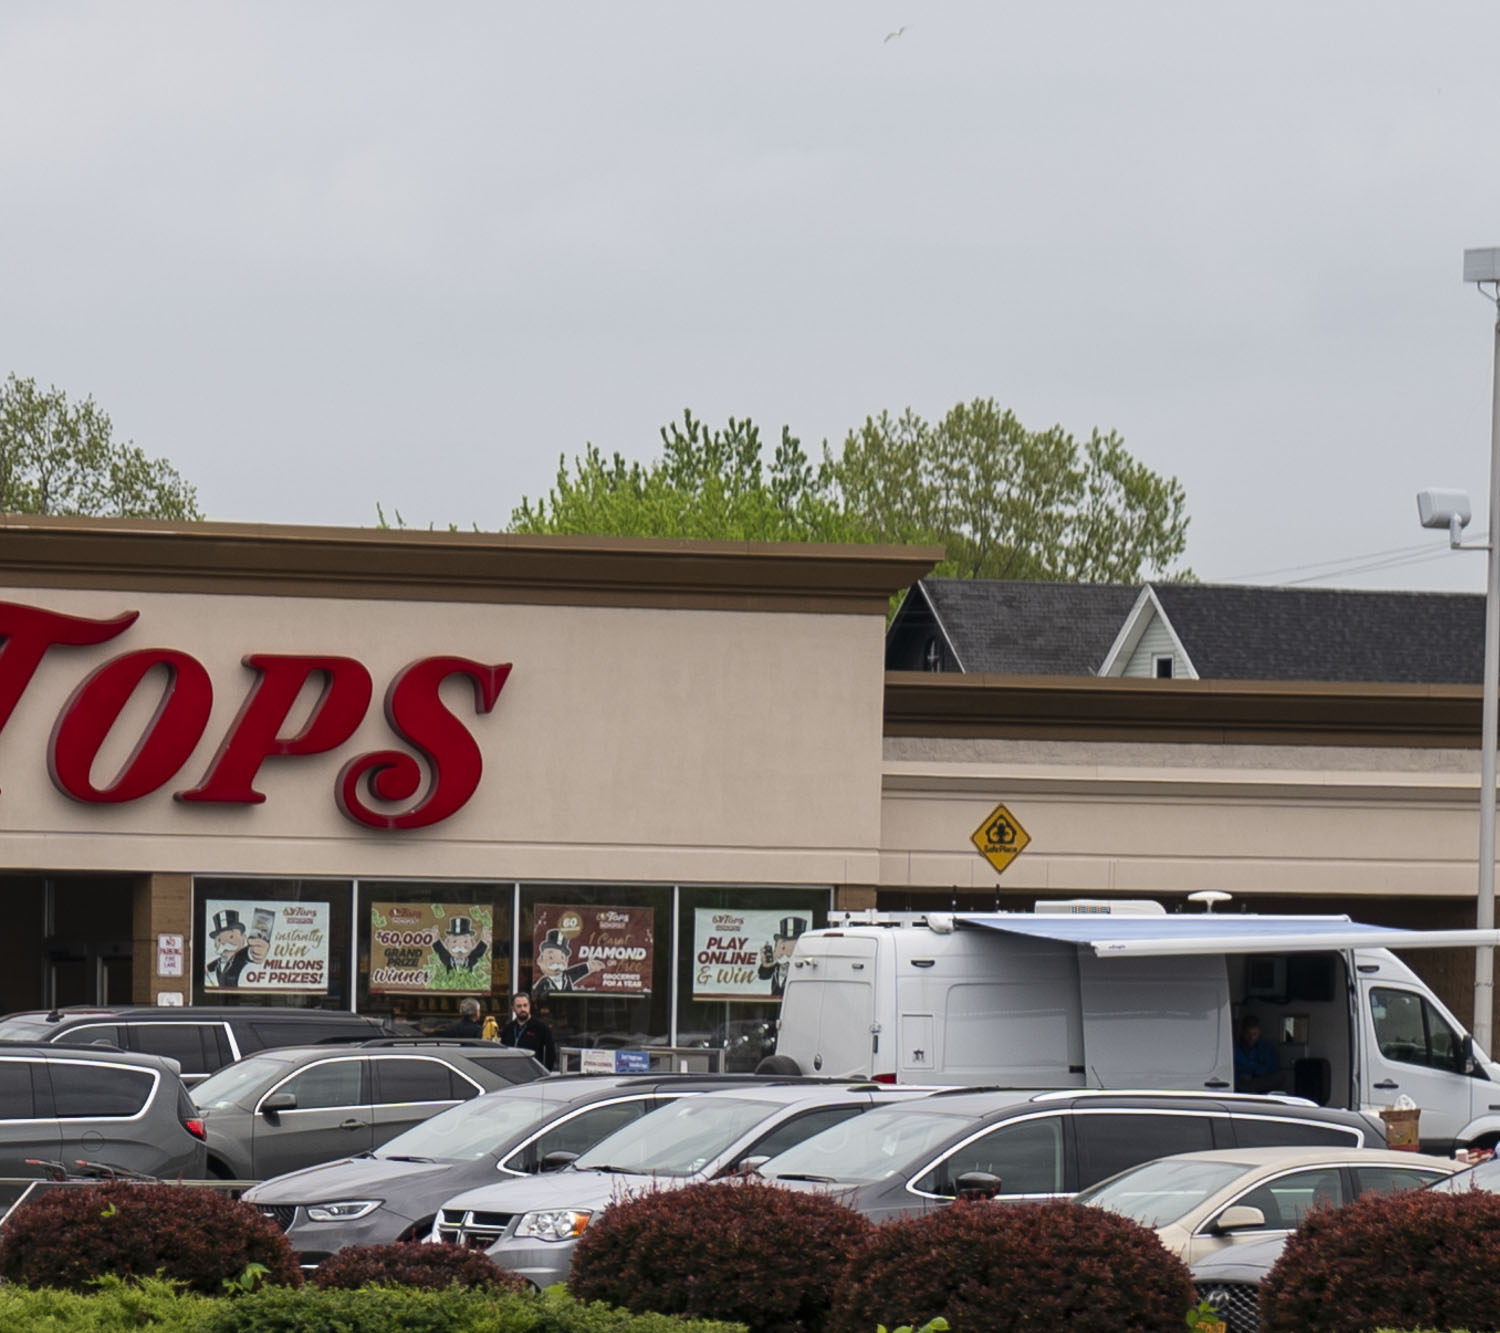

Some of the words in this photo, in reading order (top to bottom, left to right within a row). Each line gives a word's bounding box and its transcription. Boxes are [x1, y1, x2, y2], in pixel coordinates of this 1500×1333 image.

[376, 931, 433, 946] $60,000
[707, 937, 749, 950] PLAY
[384, 948, 423, 957] GRAND
[578, 946, 646, 960] DIAMOND
[698, 951, 758, 965] ONLINE
[263, 960, 324, 970] MILLIONS
[387, 958, 419, 967] PRIZE
[246, 971, 266, 983] OF
[268, 972, 323, 984] PRIZES!
